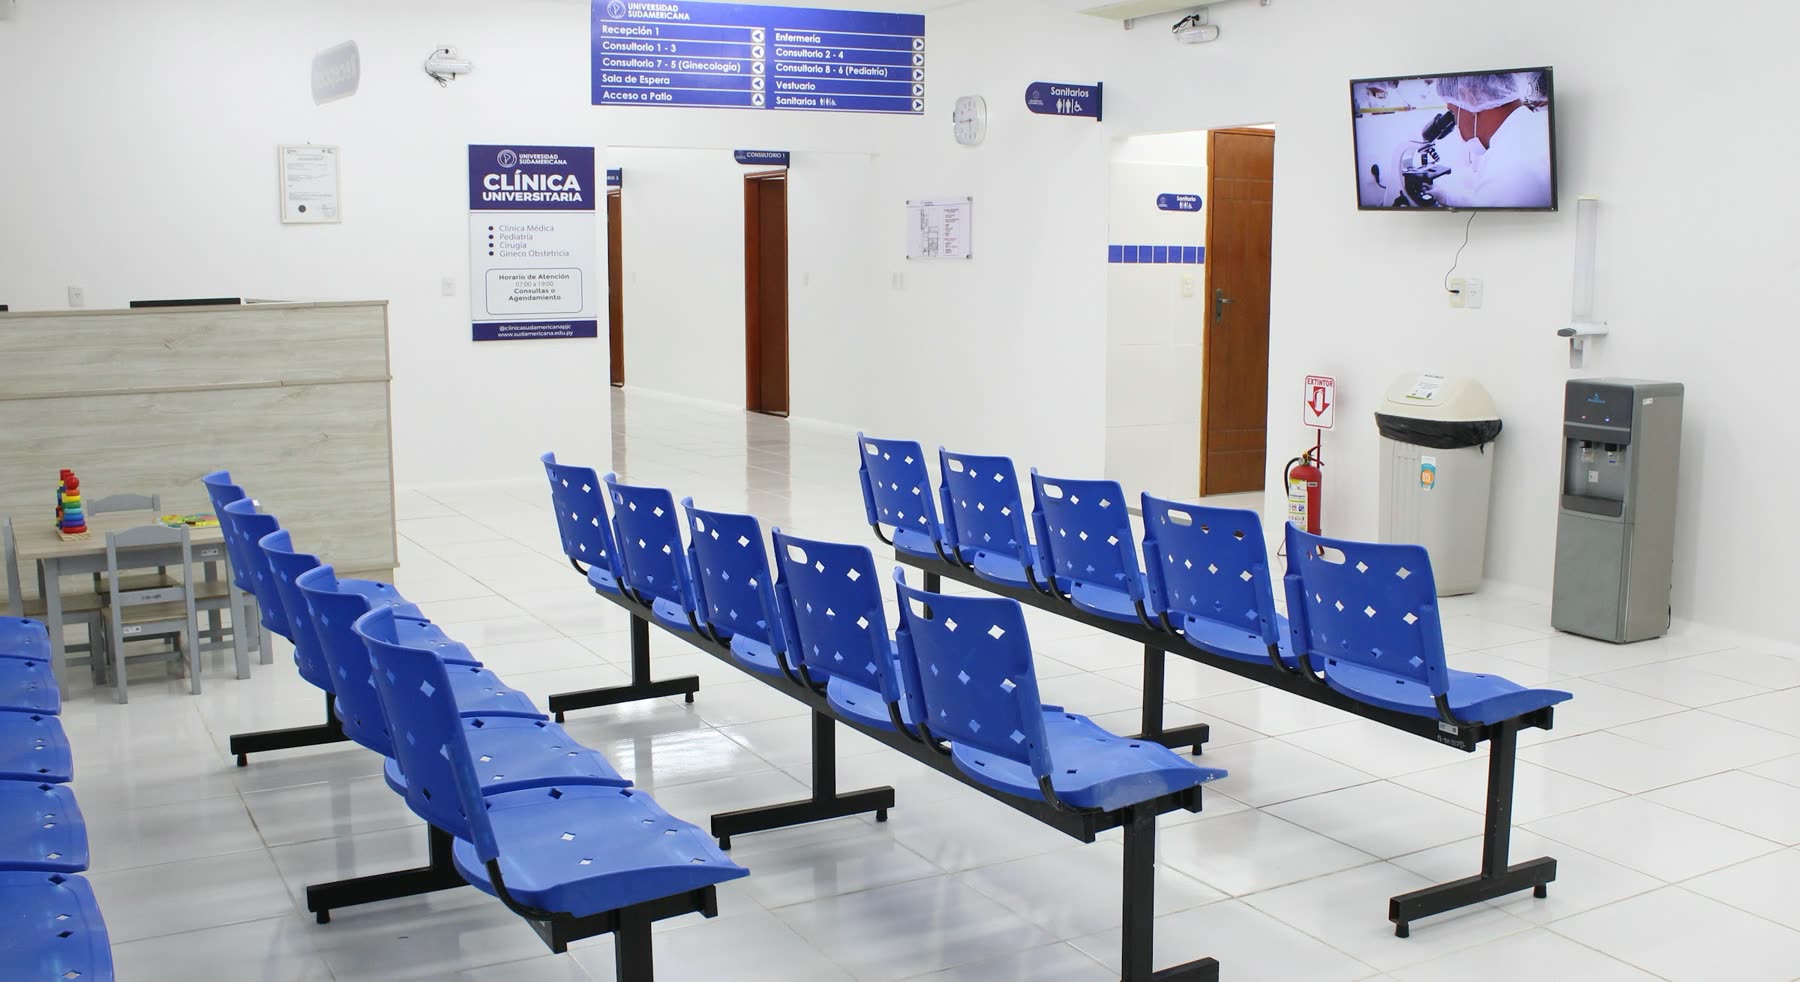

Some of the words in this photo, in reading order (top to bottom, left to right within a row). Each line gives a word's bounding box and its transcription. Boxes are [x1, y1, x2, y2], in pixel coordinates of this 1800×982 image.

[628, 3, 678, 12] UNIVERSIDAD
[628, 11, 690, 20] SUDAMERICANA
[602, 25, 652, 36] Recepción
[775, 33, 821, 43] Enfermería
[602, 41, 654, 51] Consultorio
[657, 43, 661, 51] 1
[670, 44, 677, 52] 3
[776, 48, 823, 58] Consultorio
[825, 50, 830, 59] 2
[838, 51, 844, 59] 4
[602, 57, 654, 68] Consultorio
[656, 60, 662, 68] 7
[671, 60, 676, 69] 5
[678, 61, 741, 73] (Ginecología)
[776, 63, 823, 73] Consultorio
[825, 65, 830, 74] 8
[838, 65, 843, 74] 6
[845, 66, 888, 77] (Pediatría)
[602, 74, 622, 83] Sala
[625, 75, 637, 84] de
[640, 75, 670, 85] Espera
[776, 81, 816, 90] Vestuario
[603, 91, 638, 100] Acceso
[650, 92, 672, 101] Patio
[1050, 86, 1089, 98] Sanitarios
[776, 96, 817, 106] Sanitarios
[483, 169, 581, 191] CLÍNICA
[482, 191, 583, 202] UNIVERSITARIA
[526, 224, 555, 232] Médica
[499, 249, 527, 257] Gineco
[528, 249, 570, 257] Obstetricia
[497, 330, 574, 338] www.sudamericana.edu.py
[1307, 378, 1333, 388] EXTINTOR
